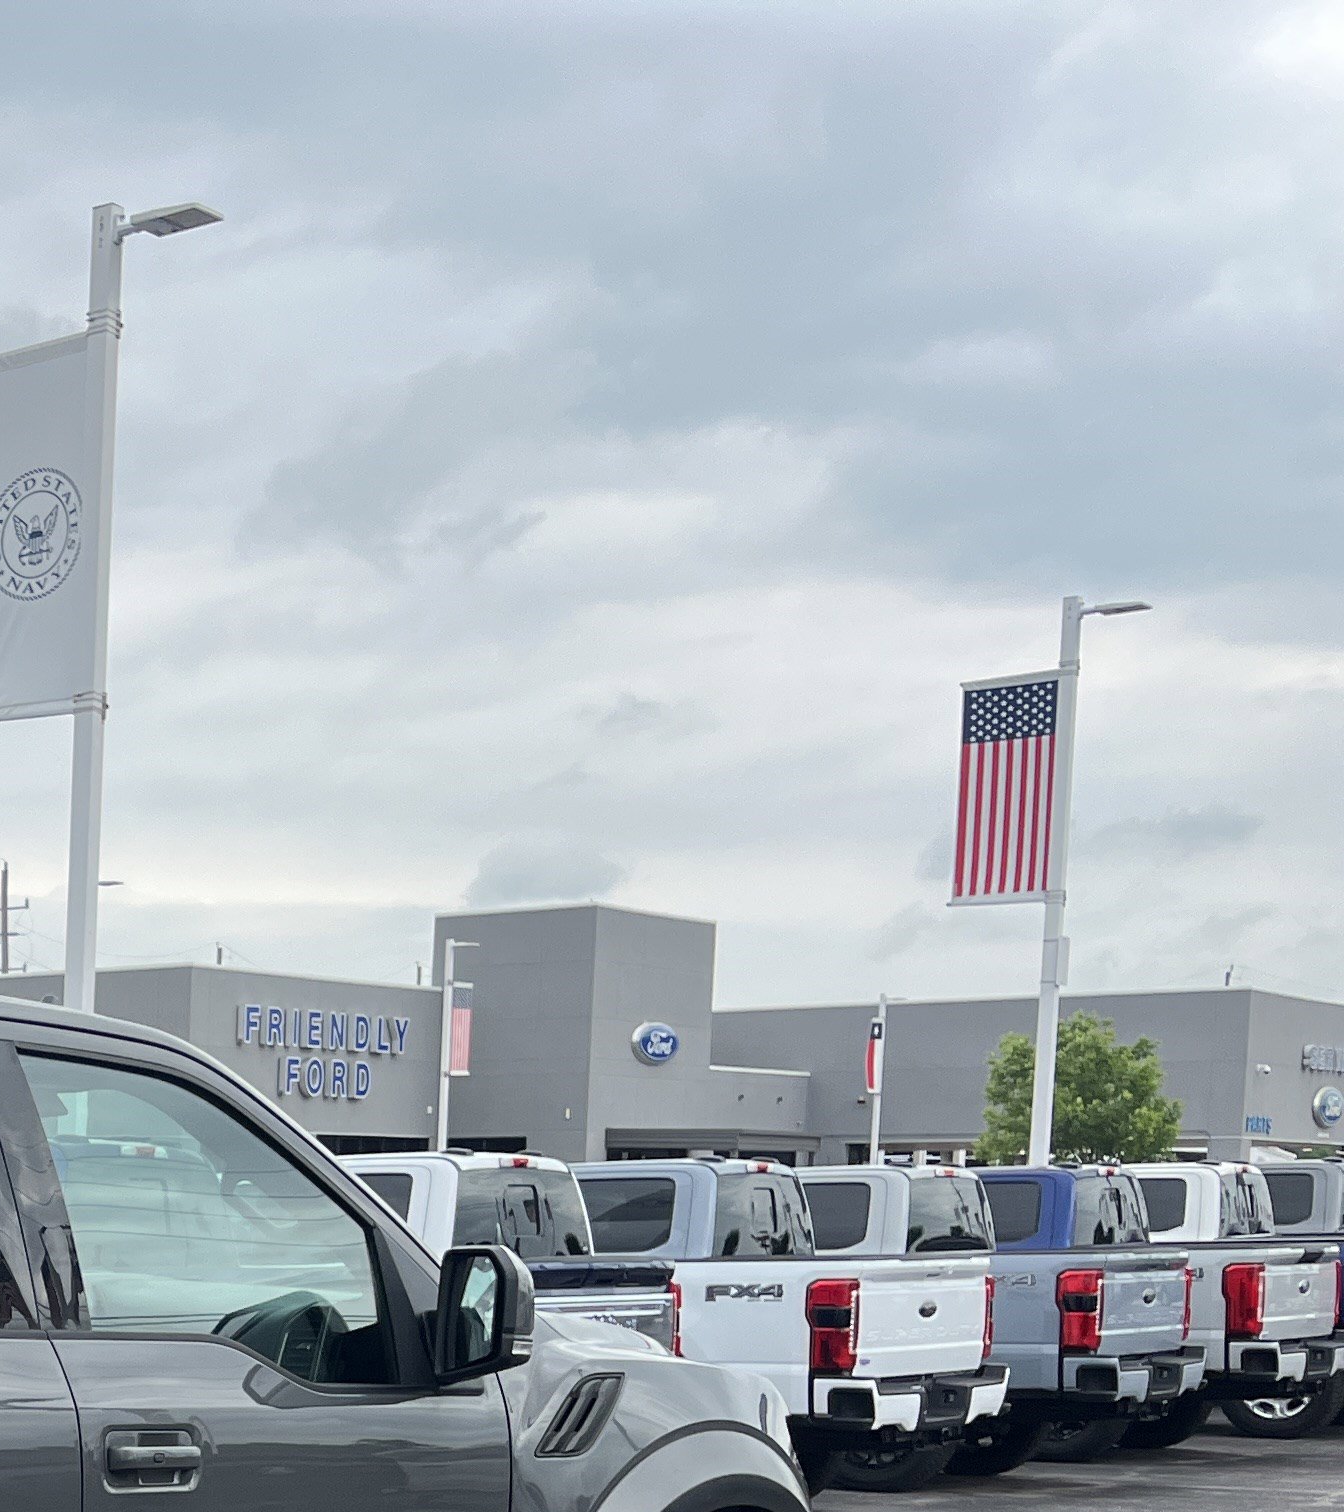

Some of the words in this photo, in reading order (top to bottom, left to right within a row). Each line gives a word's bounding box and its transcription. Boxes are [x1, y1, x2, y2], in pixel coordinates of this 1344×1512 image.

[41, 474, 79, 550] STATES
[6, 564, 61, 595] NAVY
[243, 1004, 410, 1054] FRIENDLY
[284, 1056, 372, 1099] FORD
[704, 1283, 784, 1303] FX4
